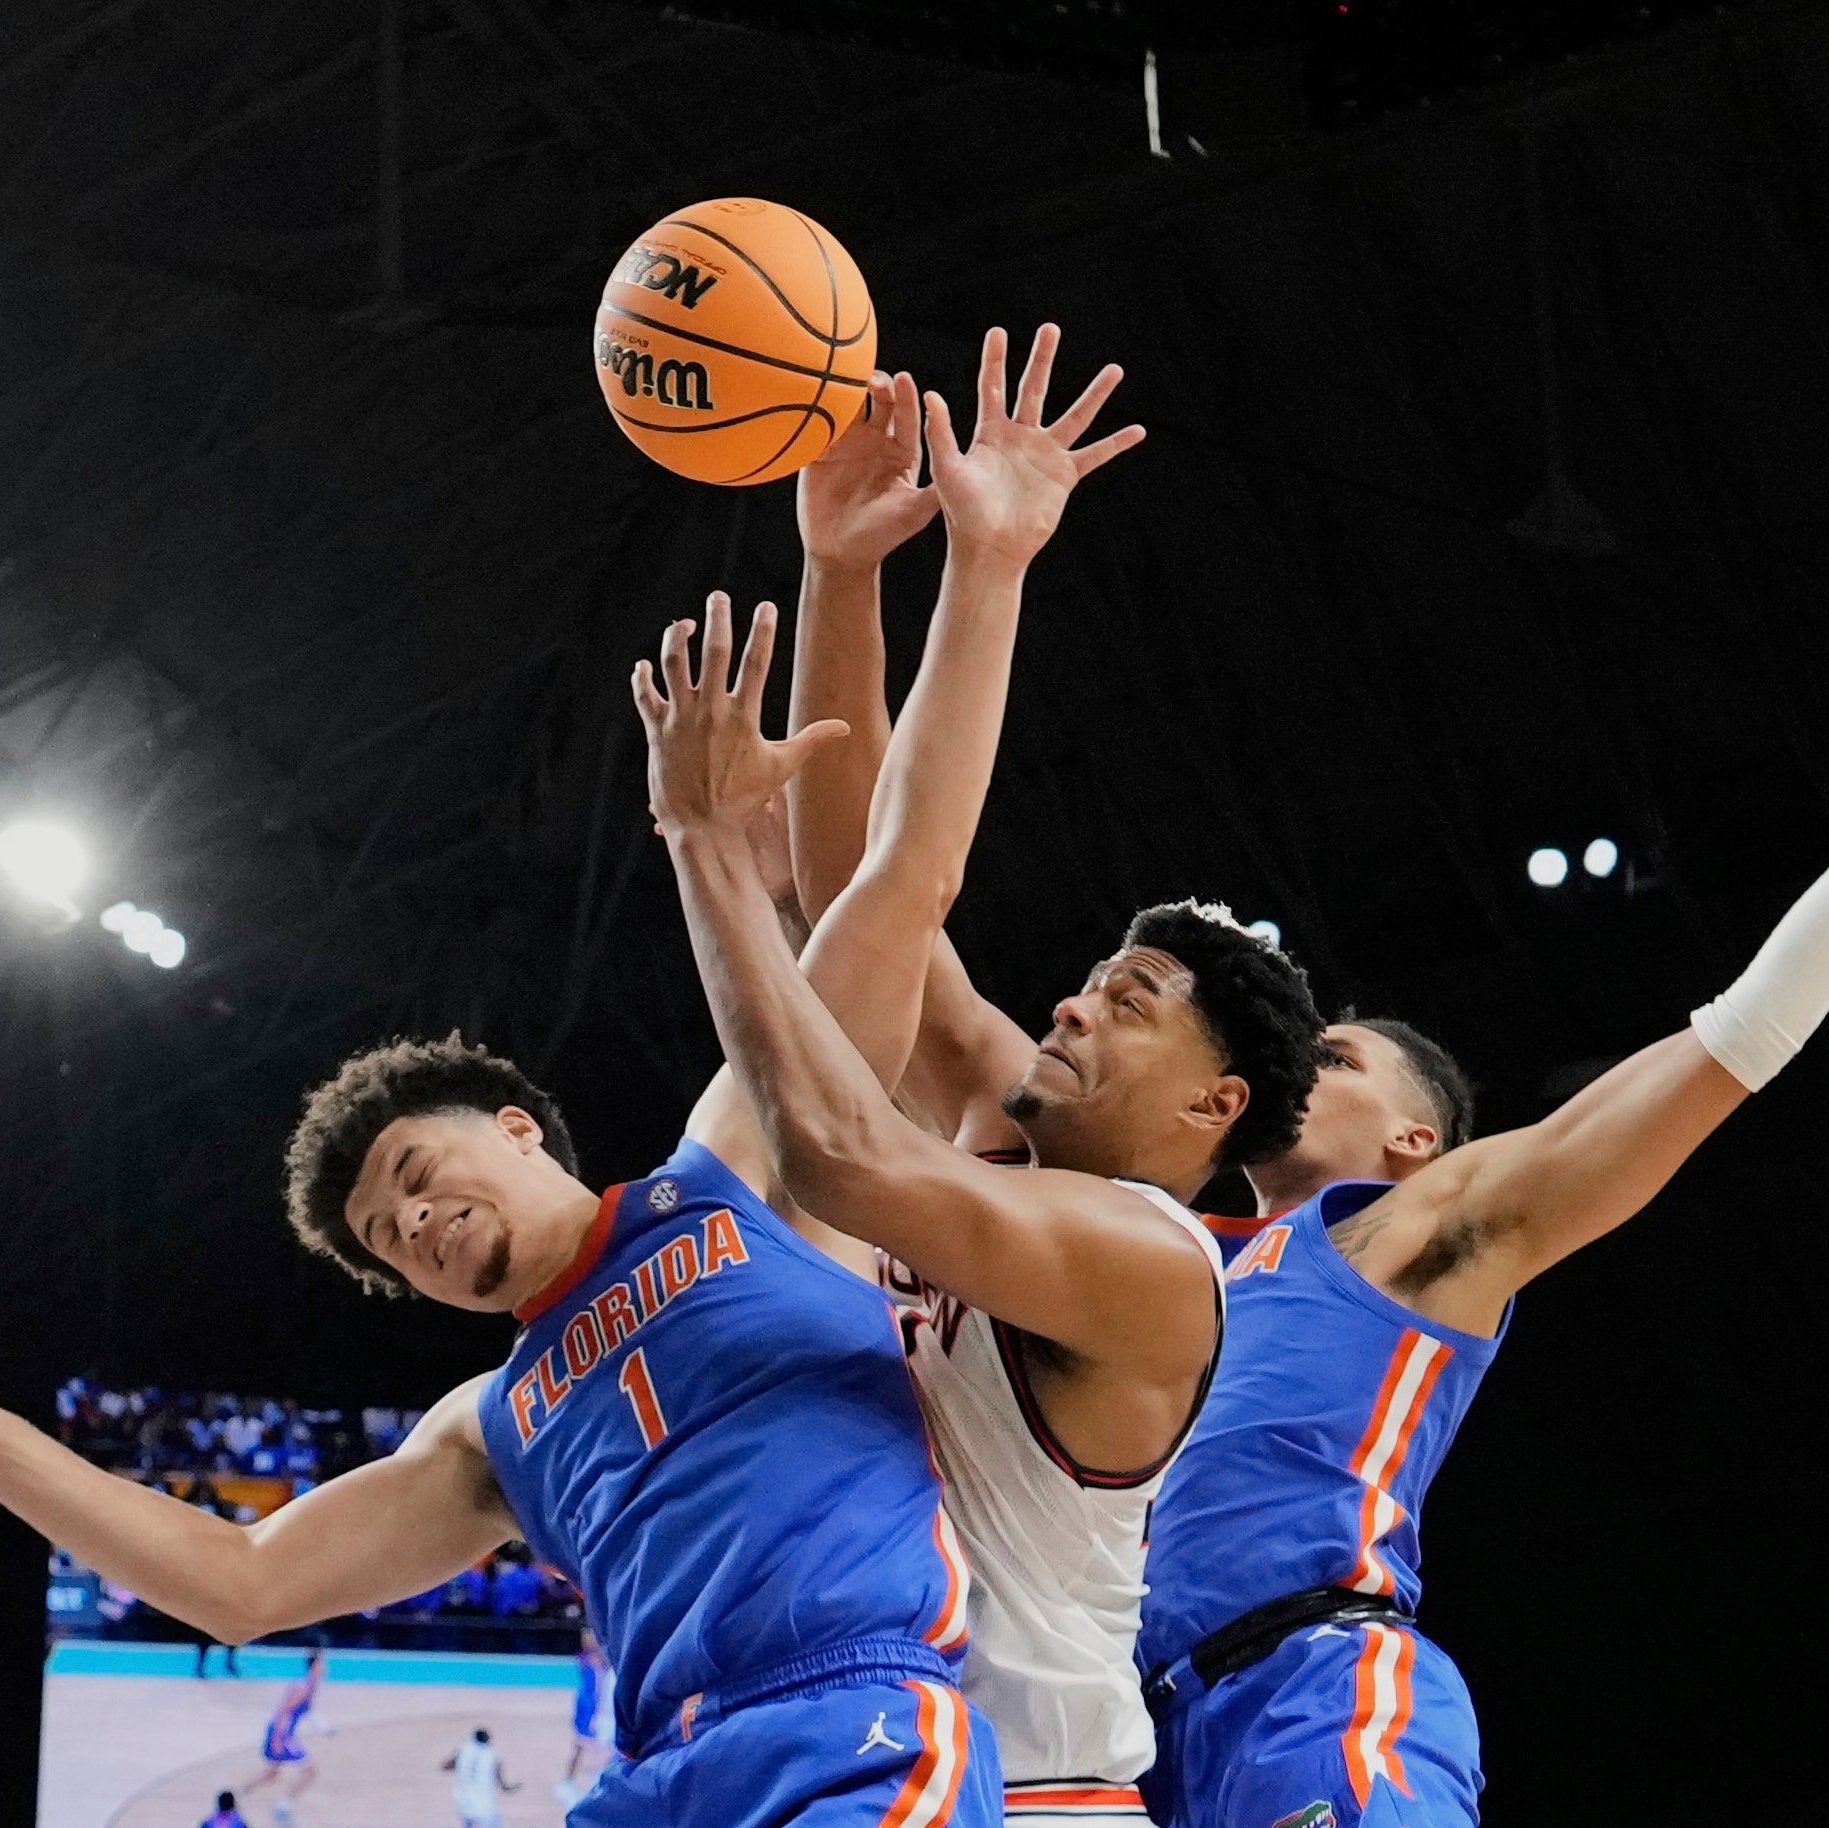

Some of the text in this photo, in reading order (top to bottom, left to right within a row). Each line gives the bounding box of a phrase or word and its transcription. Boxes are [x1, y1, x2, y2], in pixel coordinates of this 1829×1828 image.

[598, 333, 714, 411] Wilso
[506, 1208, 750, 1450] FLORIDA
[618, 1346, 668, 1452] 1
